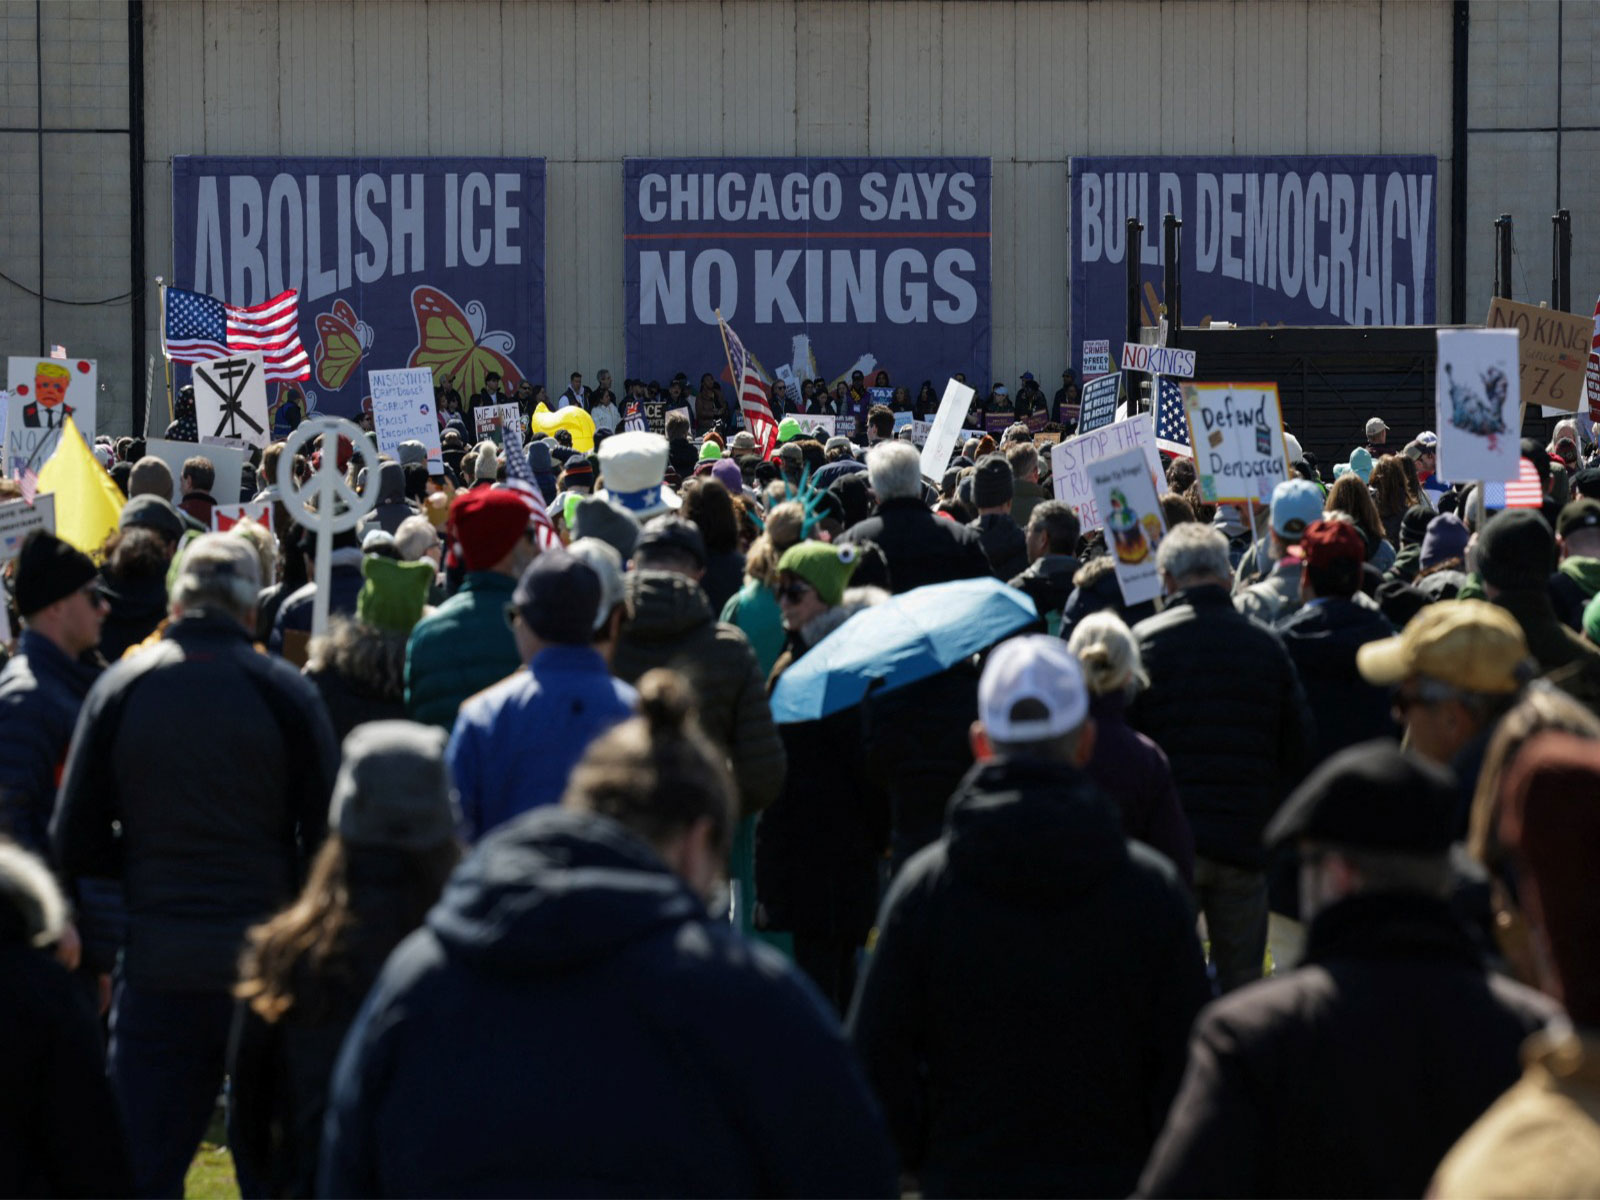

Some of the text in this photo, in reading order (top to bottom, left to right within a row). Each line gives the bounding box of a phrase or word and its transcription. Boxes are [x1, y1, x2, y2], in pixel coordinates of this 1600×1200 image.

[638, 172, 977, 222] CHICAGO SAYS
[194, 172, 522, 307] ABOLISH ICE
[1081, 171, 1432, 325] BUILD DEMOCRACY
[639, 248, 978, 325] NO KINGS
[1534, 316, 1588, 354] KING
[1088, 356, 1104, 364] FREE
[373, 372, 432, 387] MISOGYNIST
[872, 390, 894, 398] TAX
[1093, 394, 1115, 408] REFUSE
[376, 400, 414, 412] CORRUPT
[1092, 404, 1114, 417] ACCEPT
[378, 414, 408, 426] RACIST
[476, 408, 490, 421] WE
[381, 424, 432, 438] INCOMPETENT
[10, 430, 36, 452] NO
[1064, 431, 1108, 470] STOP
